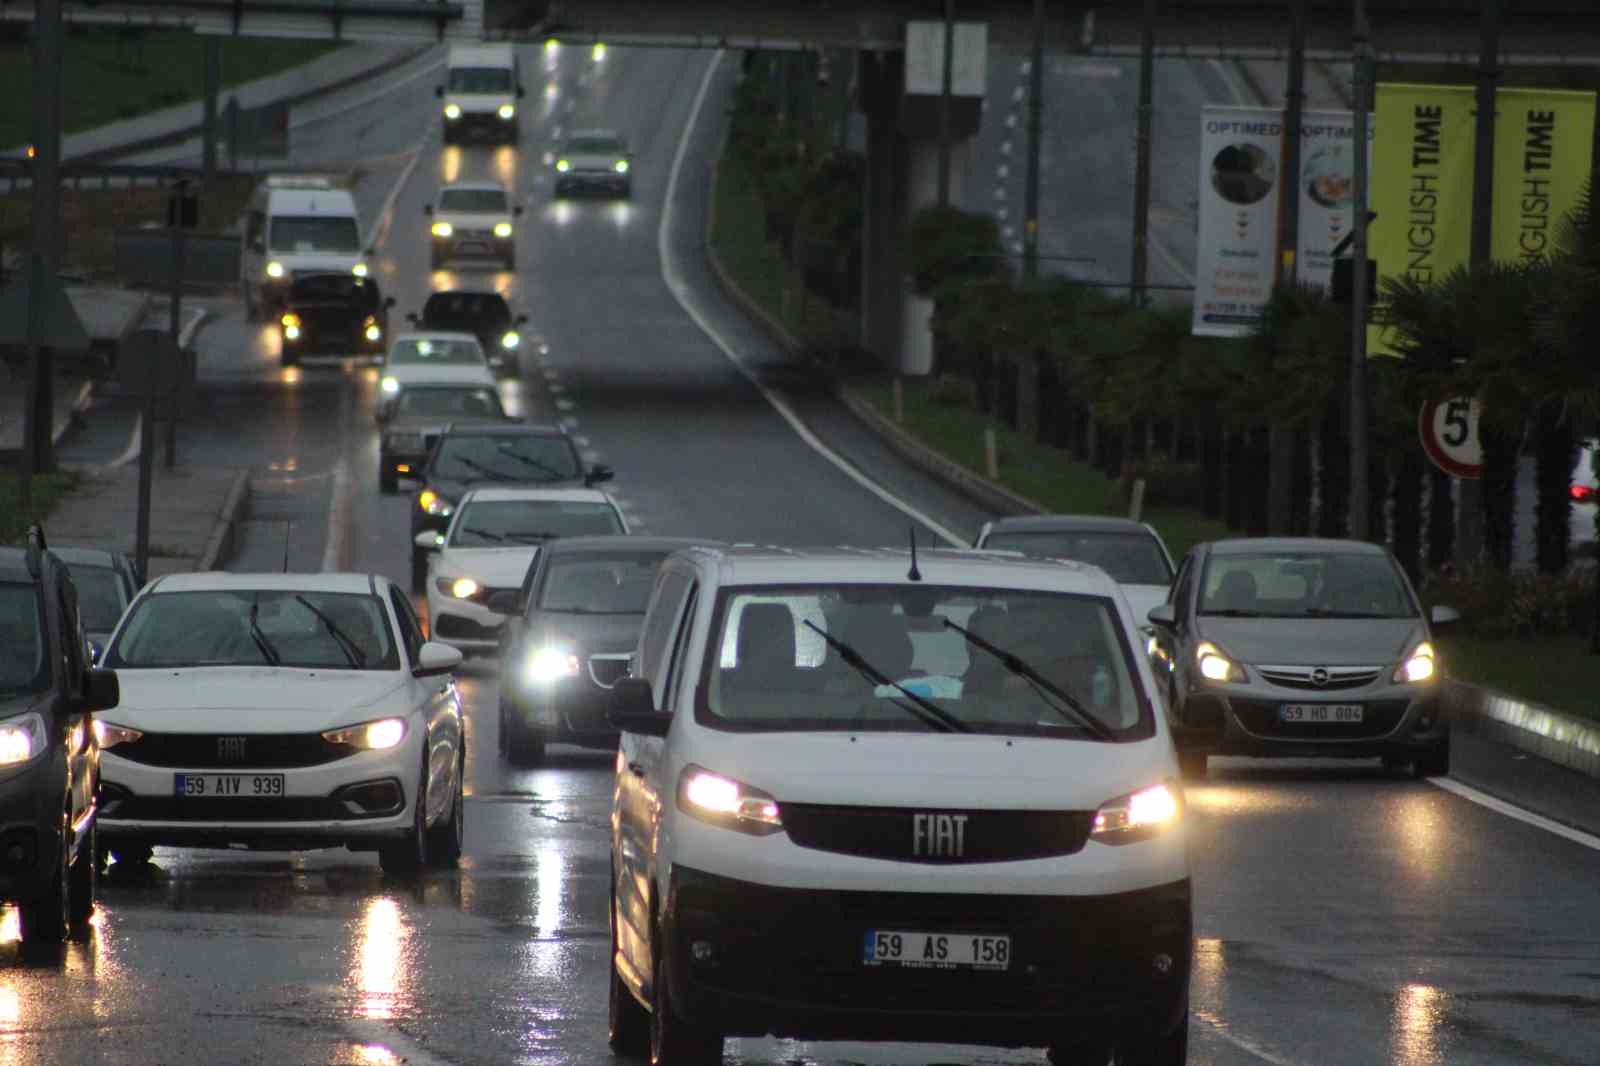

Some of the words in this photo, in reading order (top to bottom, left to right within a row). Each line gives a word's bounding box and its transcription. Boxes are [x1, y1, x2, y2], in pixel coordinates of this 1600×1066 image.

[1207, 120, 1280, 137] OPTIMED
[1412, 104, 1442, 168] TIME
[1524, 110, 1555, 173] TIME
[1408, 176, 1438, 285] ENGLISH
[1286, 706, 1303, 720] 59
[217, 736, 247, 760] FIAT
[186, 776, 205, 795] 59
[215, 776, 241, 795] AIV
[253, 776, 281, 794] 939
[913, 813, 969, 857] FIAT
[877, 934, 903, 958] 59
[923, 936, 949, 960] AS
[971, 938, 1008, 963] 158
